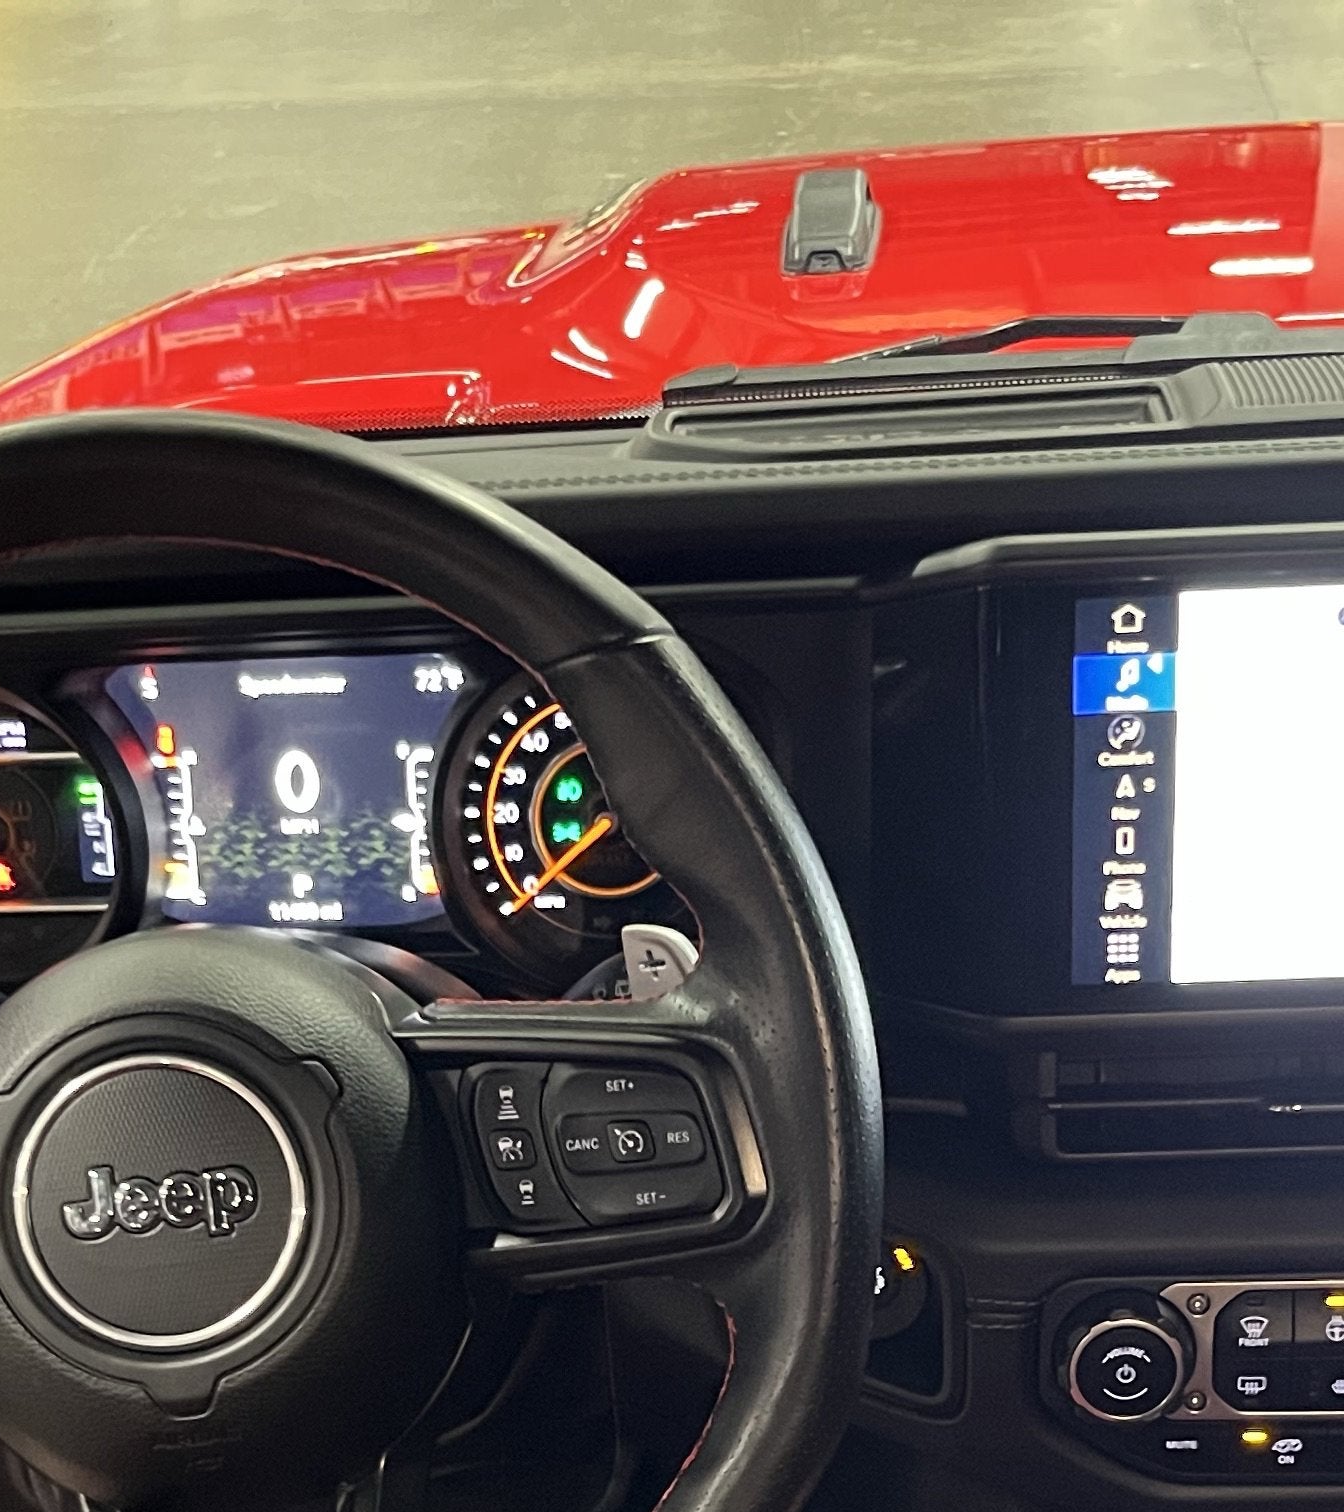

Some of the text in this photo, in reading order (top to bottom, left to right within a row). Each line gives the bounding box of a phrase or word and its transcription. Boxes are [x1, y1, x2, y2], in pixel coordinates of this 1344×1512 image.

[274, 749, 321, 814] 0
[493, 802, 520, 824] 20
[292, 873, 314, 899] P
[565, 1137, 600, 1151] CANC
[666, 1130, 690, 1144] RES
[62, 1165, 259, 1241] Jeep
[1238, 1337, 1270, 1347] FRONT
[1277, 1454, 1295, 1465] ON
